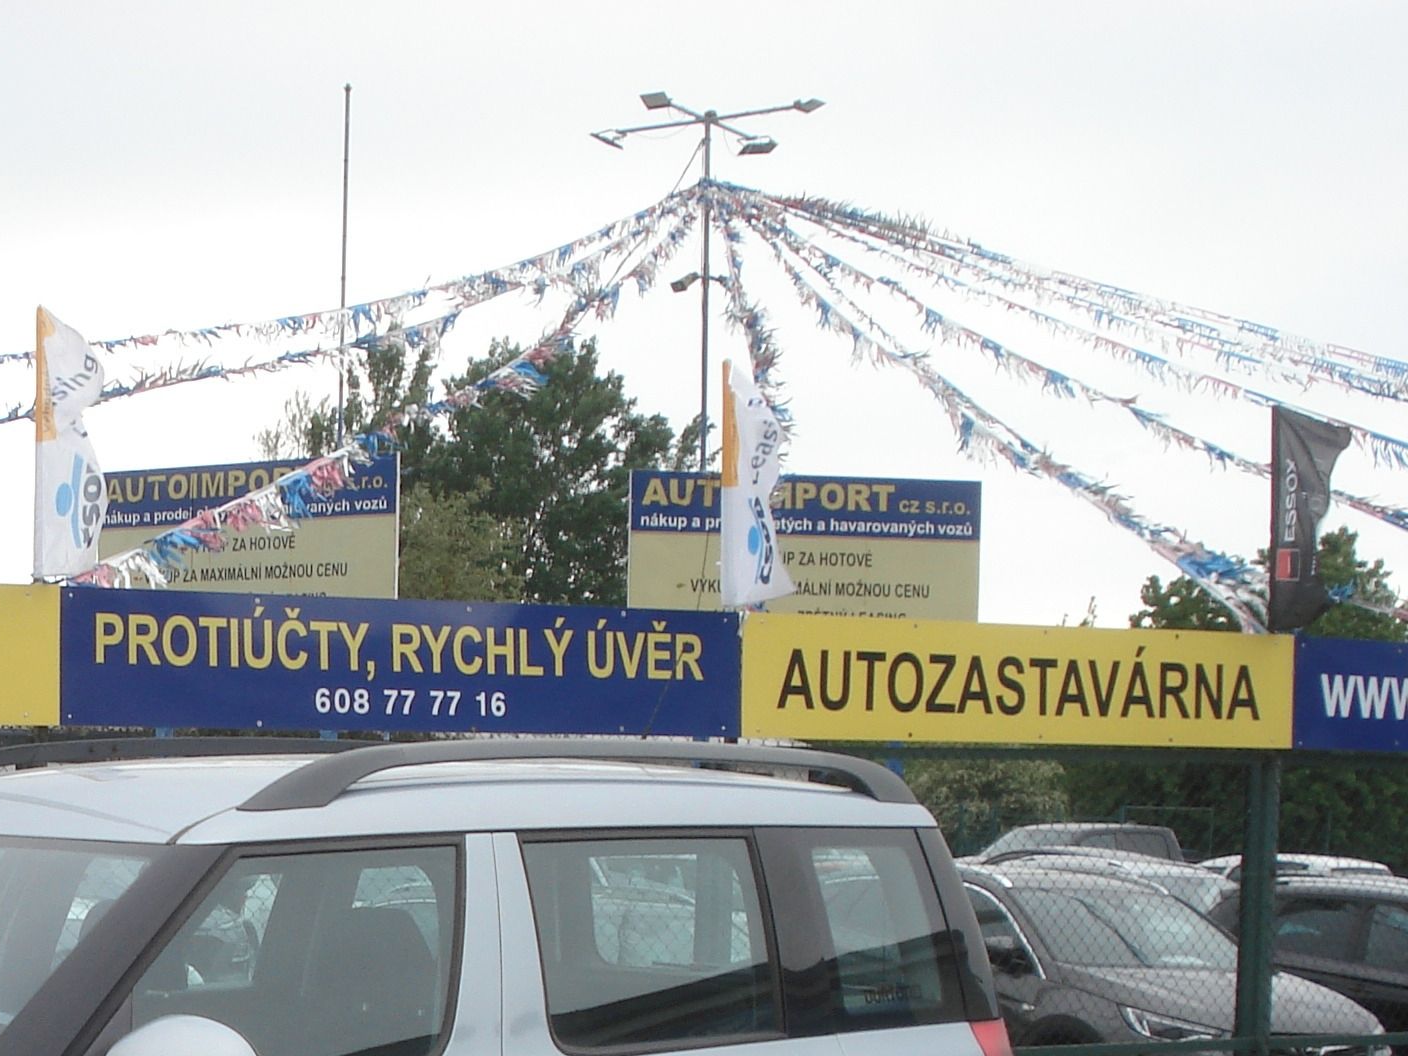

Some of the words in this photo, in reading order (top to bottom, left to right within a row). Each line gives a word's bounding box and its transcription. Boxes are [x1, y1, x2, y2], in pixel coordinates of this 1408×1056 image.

[105, 465, 294, 504] AUTOIMPO
[354, 496, 388, 510] vozů
[642, 477, 895, 513] AUTPORT
[898, 500, 920, 514] cz
[925, 501, 971, 516] s.r.o.
[1284, 458, 1298, 542] ESSOX
[143, 513, 151, 522] a
[640, 512, 688, 530] nákup
[692, 517, 701, 528] a
[817, 520, 826, 531] a
[830, 517, 935, 537] havarovaných
[938, 521, 973, 535] vozů
[232, 537, 247, 551] ZA
[798, 551, 815, 566] ZA
[819, 549, 873, 567] HOTOVÉ
[183, 568, 197, 583] ZA
[200, 563, 262, 582] MAXIMÁLNÍ
[264, 562, 314, 579] MOŽNOU
[317, 562, 348, 577] CENU
[835, 578, 891, 598] MOŽNOU
[894, 583, 930, 599] CENU
[94, 606, 377, 681] PROTIÚČTY,
[393, 616, 575, 679] RYCHLÝ
[586, 615, 704, 682] ÚVĚR
[777, 645, 1262, 722] AUTOZASTAVÁRNA
[314, 687, 369, 715] 608
[383, 689, 415, 716] 77
[429, 690, 461, 717] 77
[476, 692, 506, 717] 16
